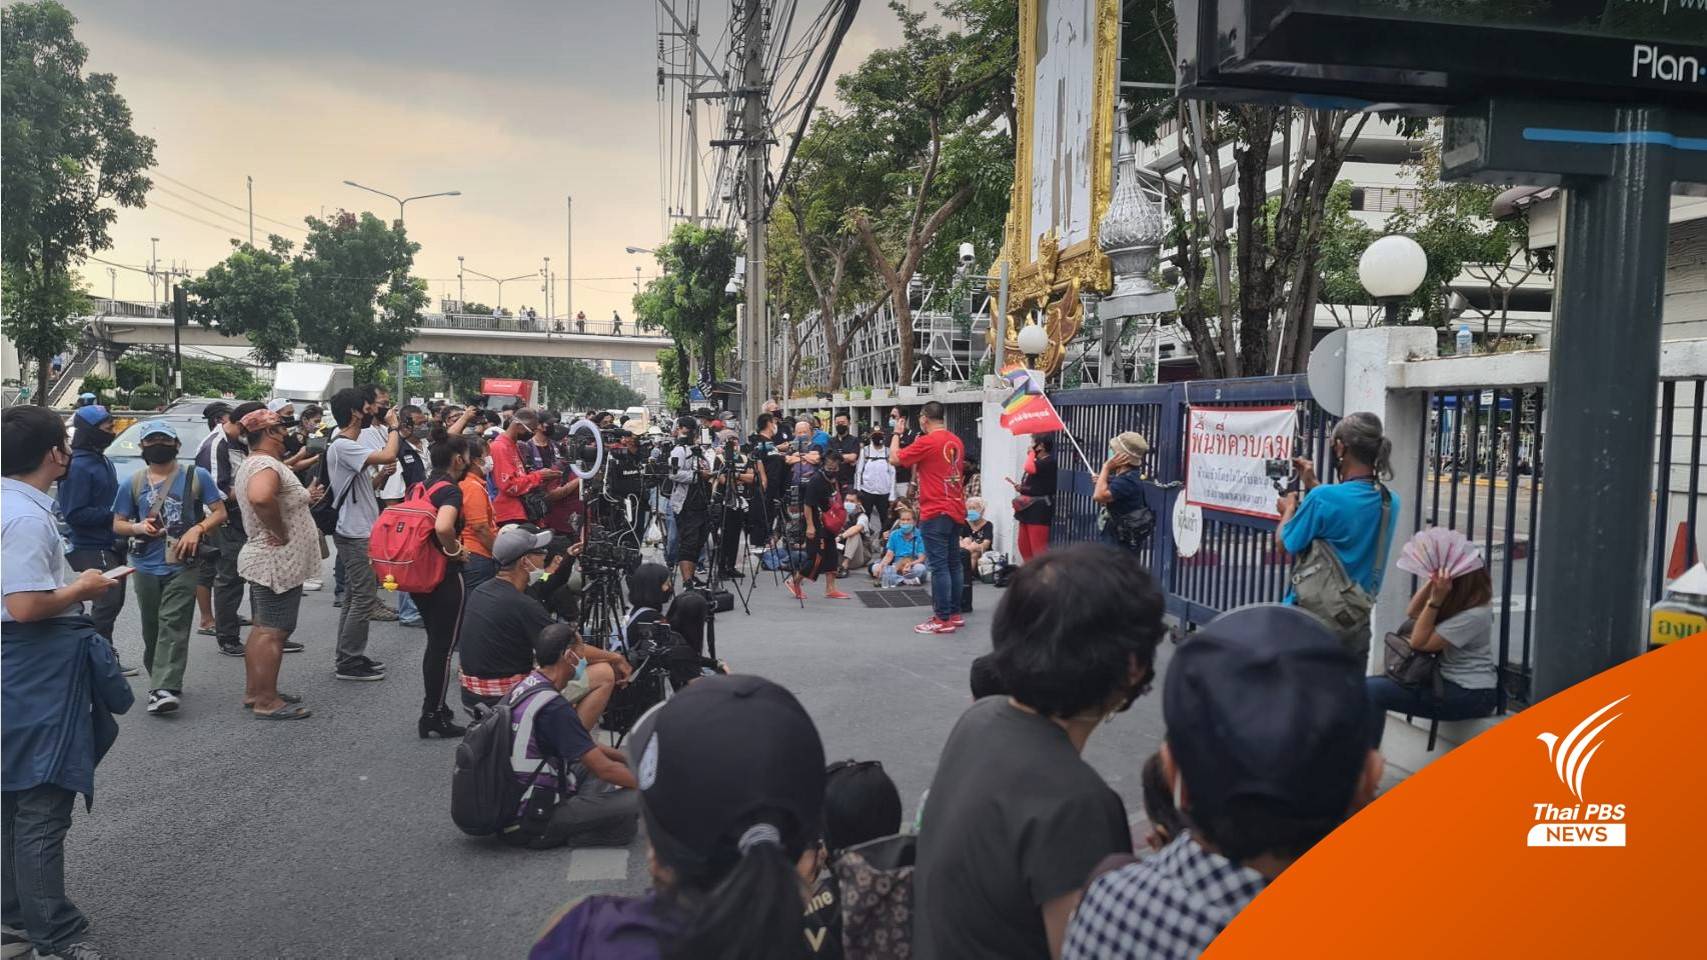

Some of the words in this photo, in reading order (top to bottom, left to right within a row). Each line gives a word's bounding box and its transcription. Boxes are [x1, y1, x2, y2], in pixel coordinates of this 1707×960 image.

[1191, 412, 1291, 459] พื้นที่ควบคม
